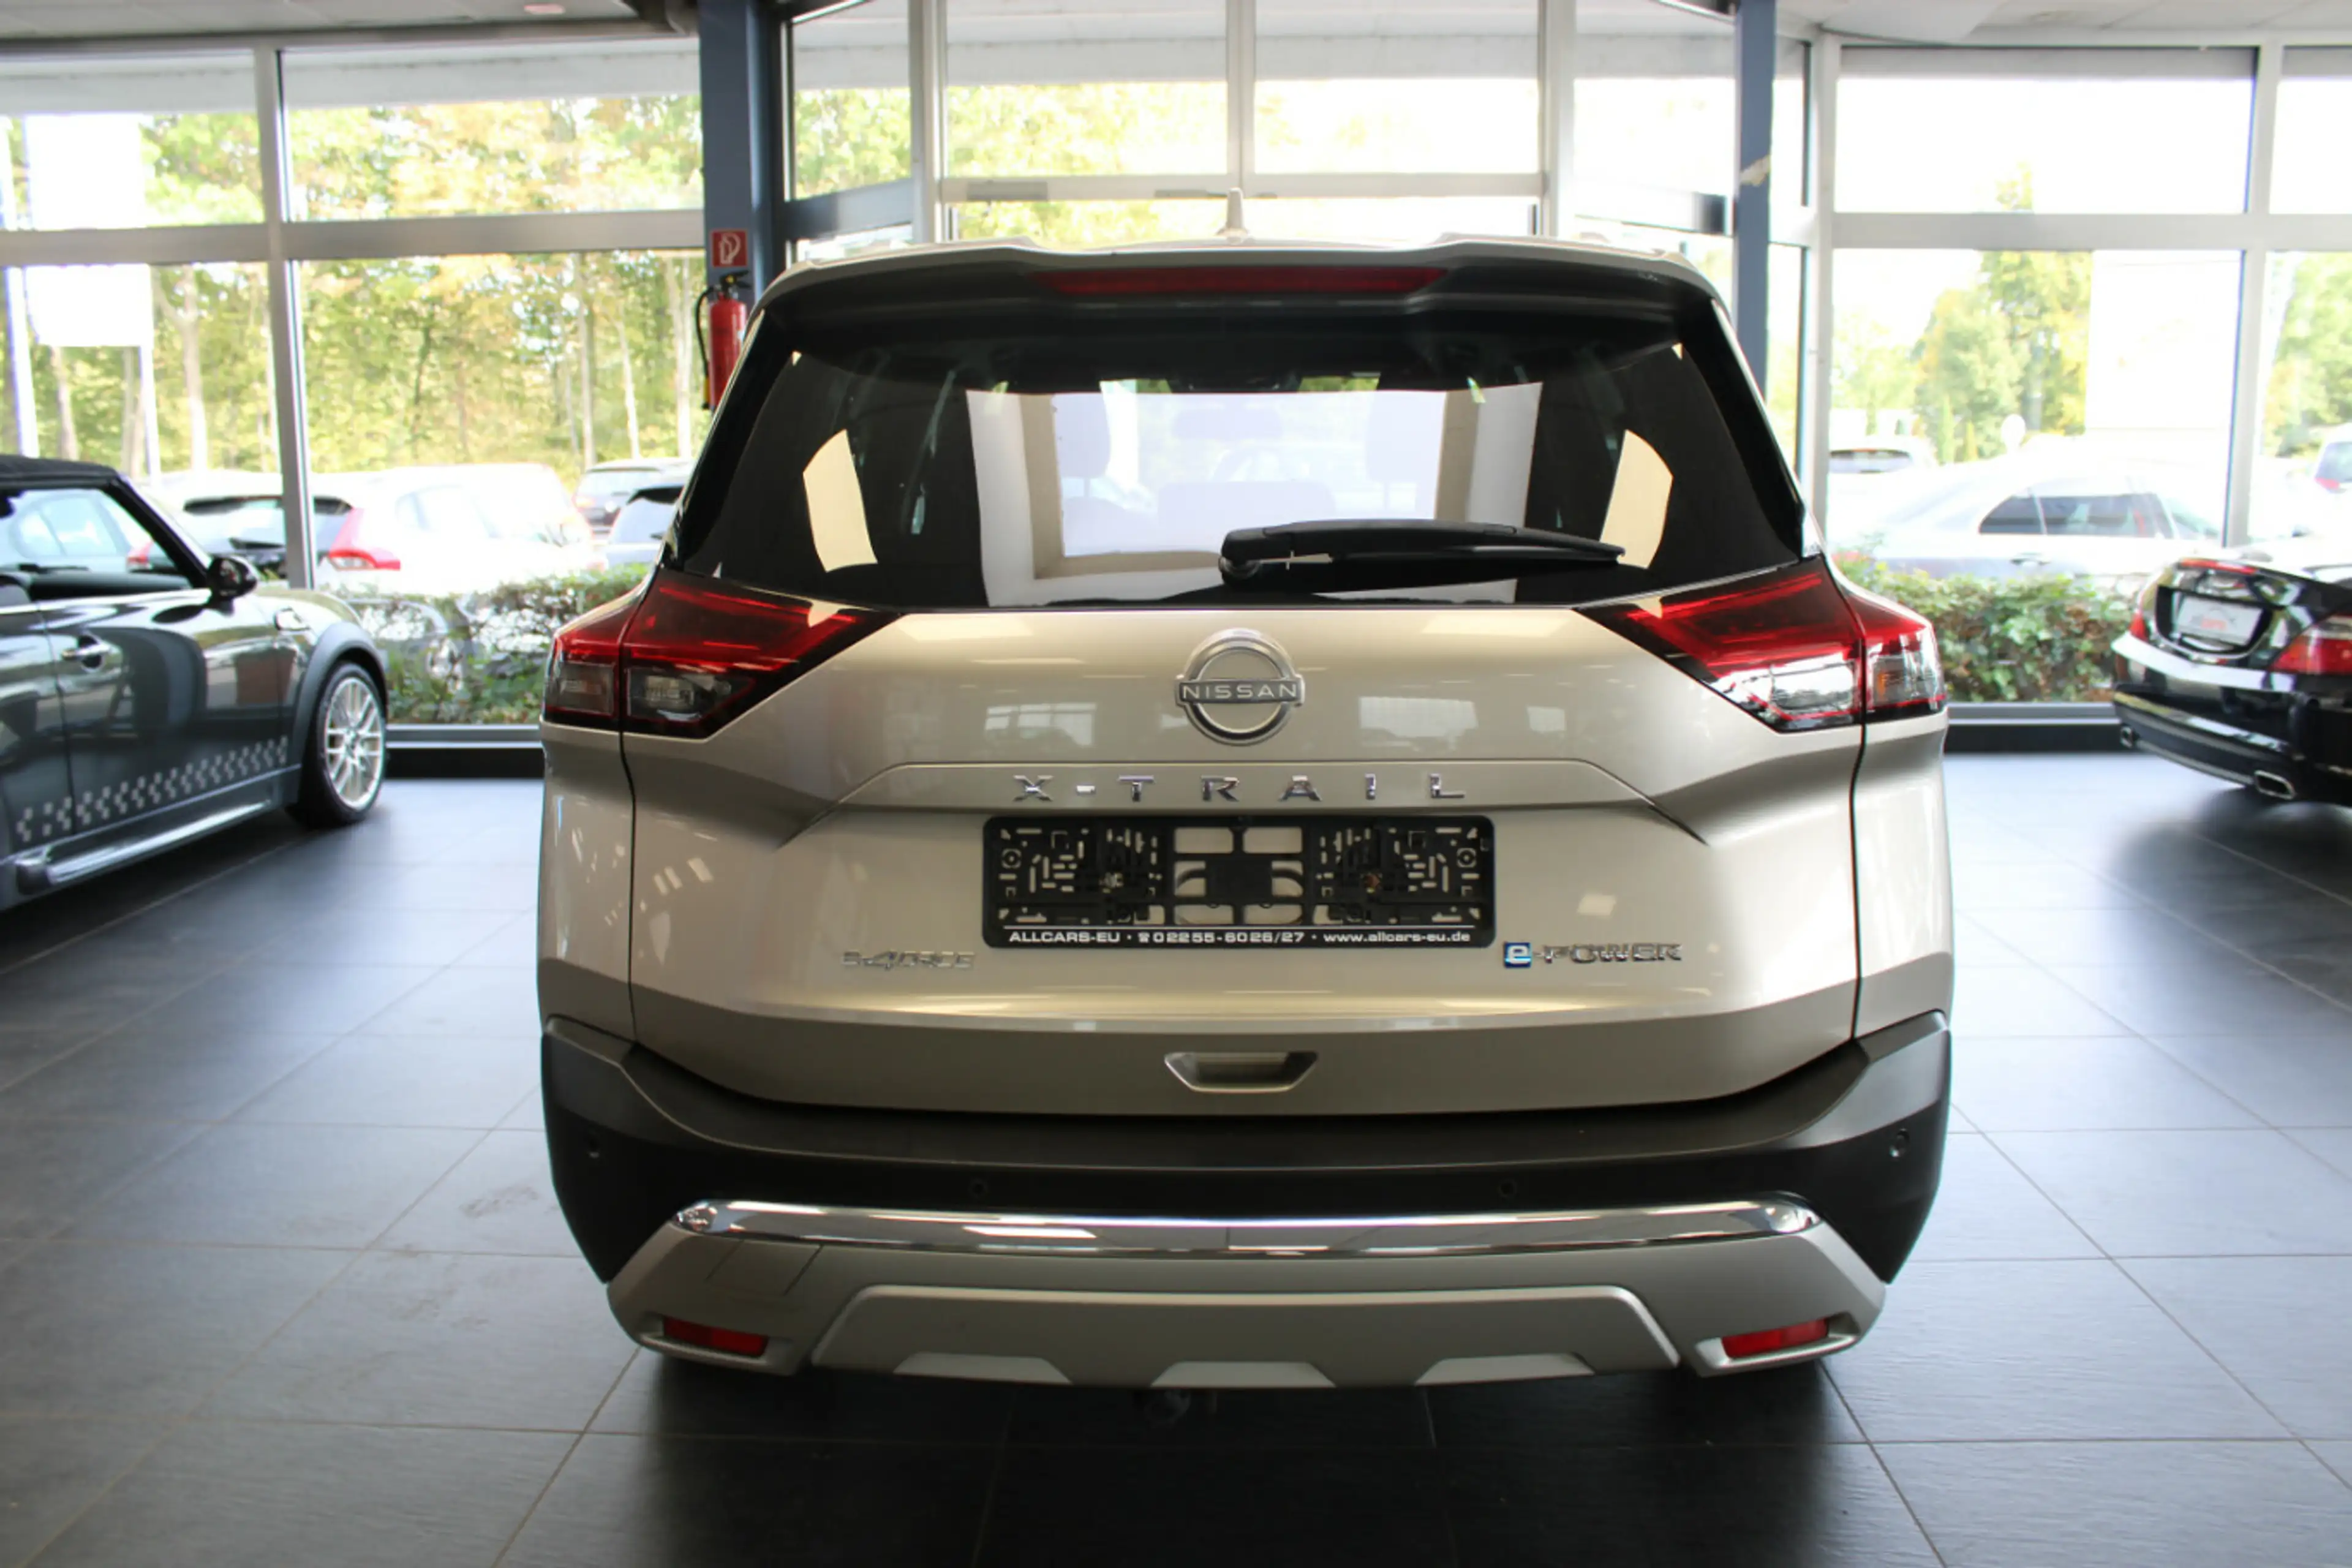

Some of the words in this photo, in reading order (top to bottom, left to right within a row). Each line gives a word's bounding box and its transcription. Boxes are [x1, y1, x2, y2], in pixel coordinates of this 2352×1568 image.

[1182, 684, 1297, 699] NISSAN
[1013, 775, 1466, 802] X-TRAIL
[1009, 932, 1121, 943] ALLCARS-EU
[1323, 931, 1471, 943] www.allcars-eu.de
